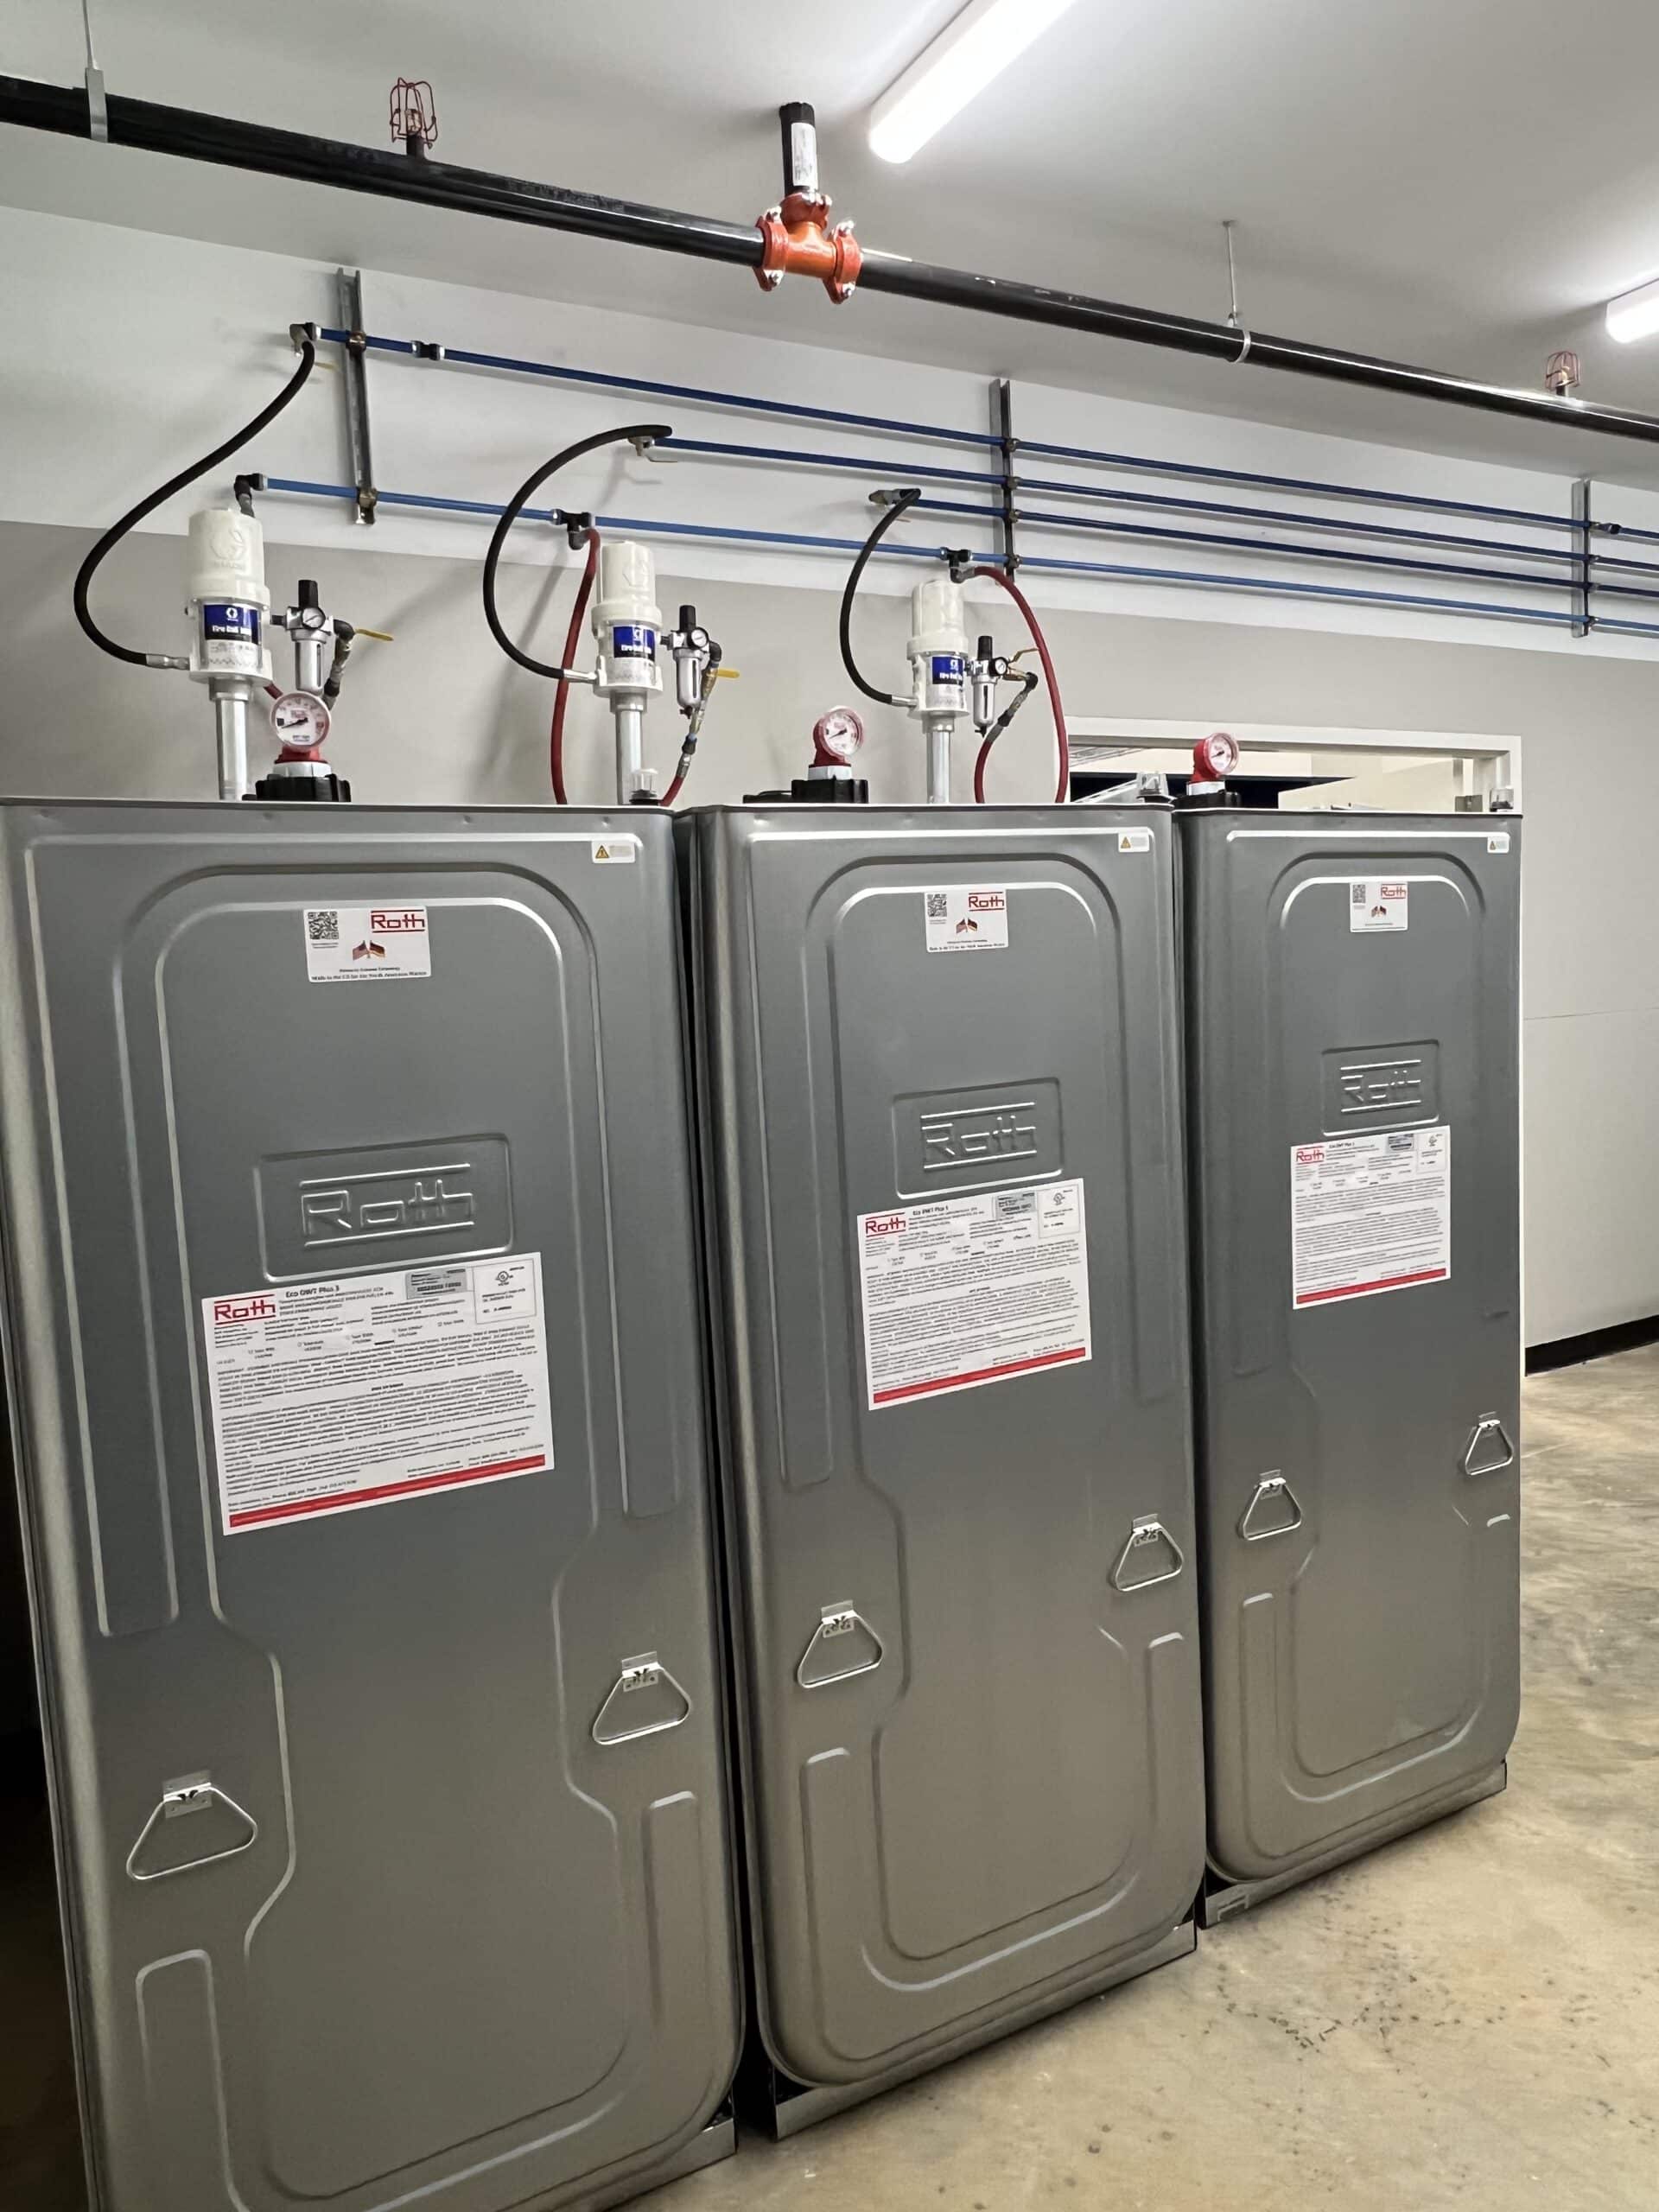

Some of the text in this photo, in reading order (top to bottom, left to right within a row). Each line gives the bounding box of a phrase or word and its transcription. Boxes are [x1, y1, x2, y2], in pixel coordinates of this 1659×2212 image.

[1381, 887, 1407, 897] Roth
[968, 895, 1004, 908] Roth
[371, 913, 425, 929] Roth
[921, 1116, 1036, 1163] Roth
[1295, 1149, 1325, 1162] Roth
[301, 1179, 476, 1236] Roth
[866, 1217, 906, 1234] Roth
[213, 1300, 276, 1320] Roth
